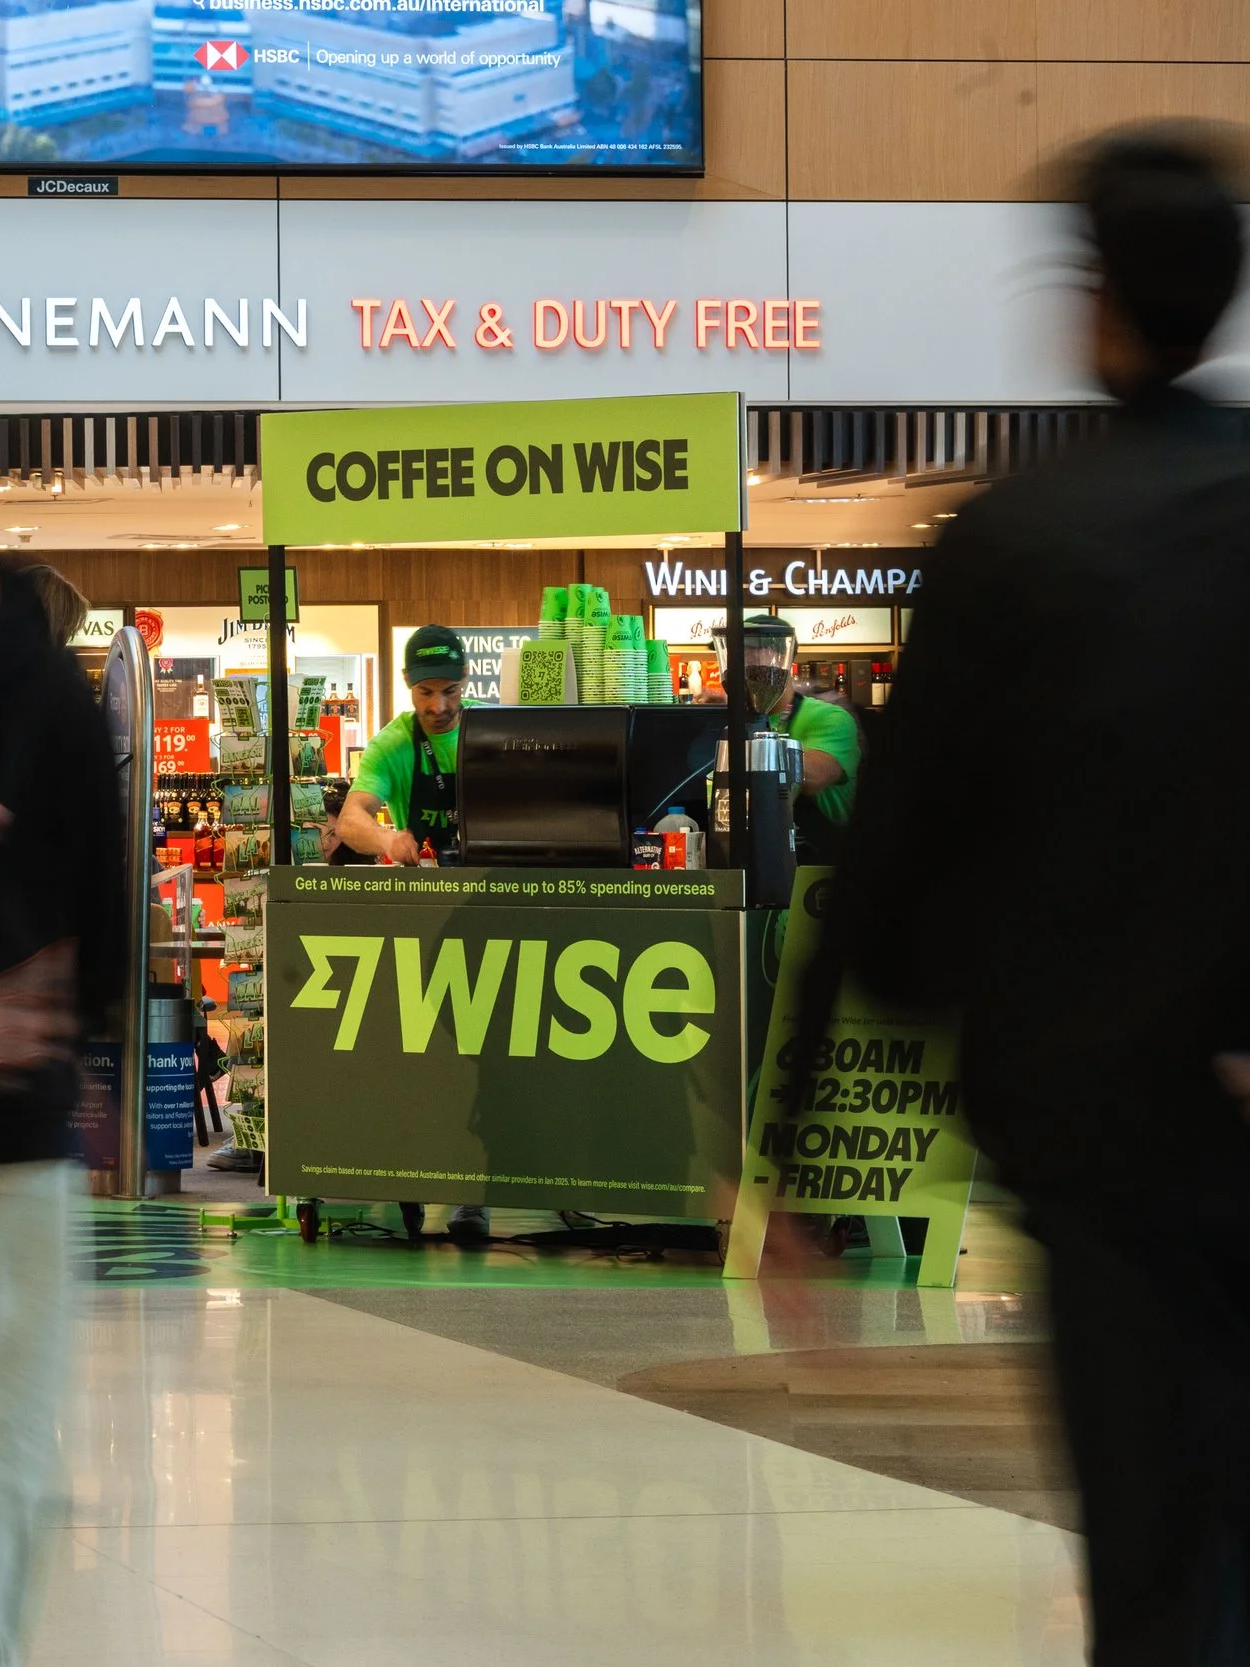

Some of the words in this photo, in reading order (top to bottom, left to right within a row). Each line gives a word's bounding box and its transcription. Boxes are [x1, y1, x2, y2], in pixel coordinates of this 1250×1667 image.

[254, 49, 300, 63] HSBC
[316, 49, 374, 68] Opening
[381, 53, 400, 67] up
[403, 53, 412, 64] a
[416, 50, 457, 65] world
[461, 50, 475, 65] of
[479, 50, 561, 69] opportunity
[36, 180, 110, 193] JCDecaux
[351, 298, 458, 350] TAX
[474, 302, 514, 350] &
[532, 298, 678, 350] DUTY
[695, 298, 823, 350] FREE
[306, 447, 476, 503] COFFEE
[485, 442, 564, 497] ON
[573, 438, 689, 493] WISE
[749, 569, 773, 595] &
[784, 561, 922, 595] CHAMPA
[78, 620, 115, 636] VAS
[461, 635, 505, 653] YING
[295, 876, 317, 891] Get
[319, 880, 328, 891] a
[330, 877, 361, 891] Wise
[364, 878, 392, 892] card
[395, 878, 406, 892] in
[409, 878, 460, 893] minutes
[462, 879, 487, 893] and
[489, 882, 519, 894] save
[522, 882, 539, 897] up
[542, 881, 555, 895] to
[558, 880, 586, 895] 85%
[590, 881, 651, 898] spending
[654, 883, 716, 896] overseas
[83, 1053, 115, 1068] tion.
[147, 1054, 178, 1069] hank
[776, 1037, 925, 1075] 630AM
[146, 1083, 178, 1093] upporting
[804, 1077, 960, 1116] 12:30PM
[149, 1102, 163, 1110] With
[150, 1122, 172, 1131] support
[759, 1122, 940, 1162] MONDAY
[776, 1164, 913, 1202] FRIDAY
